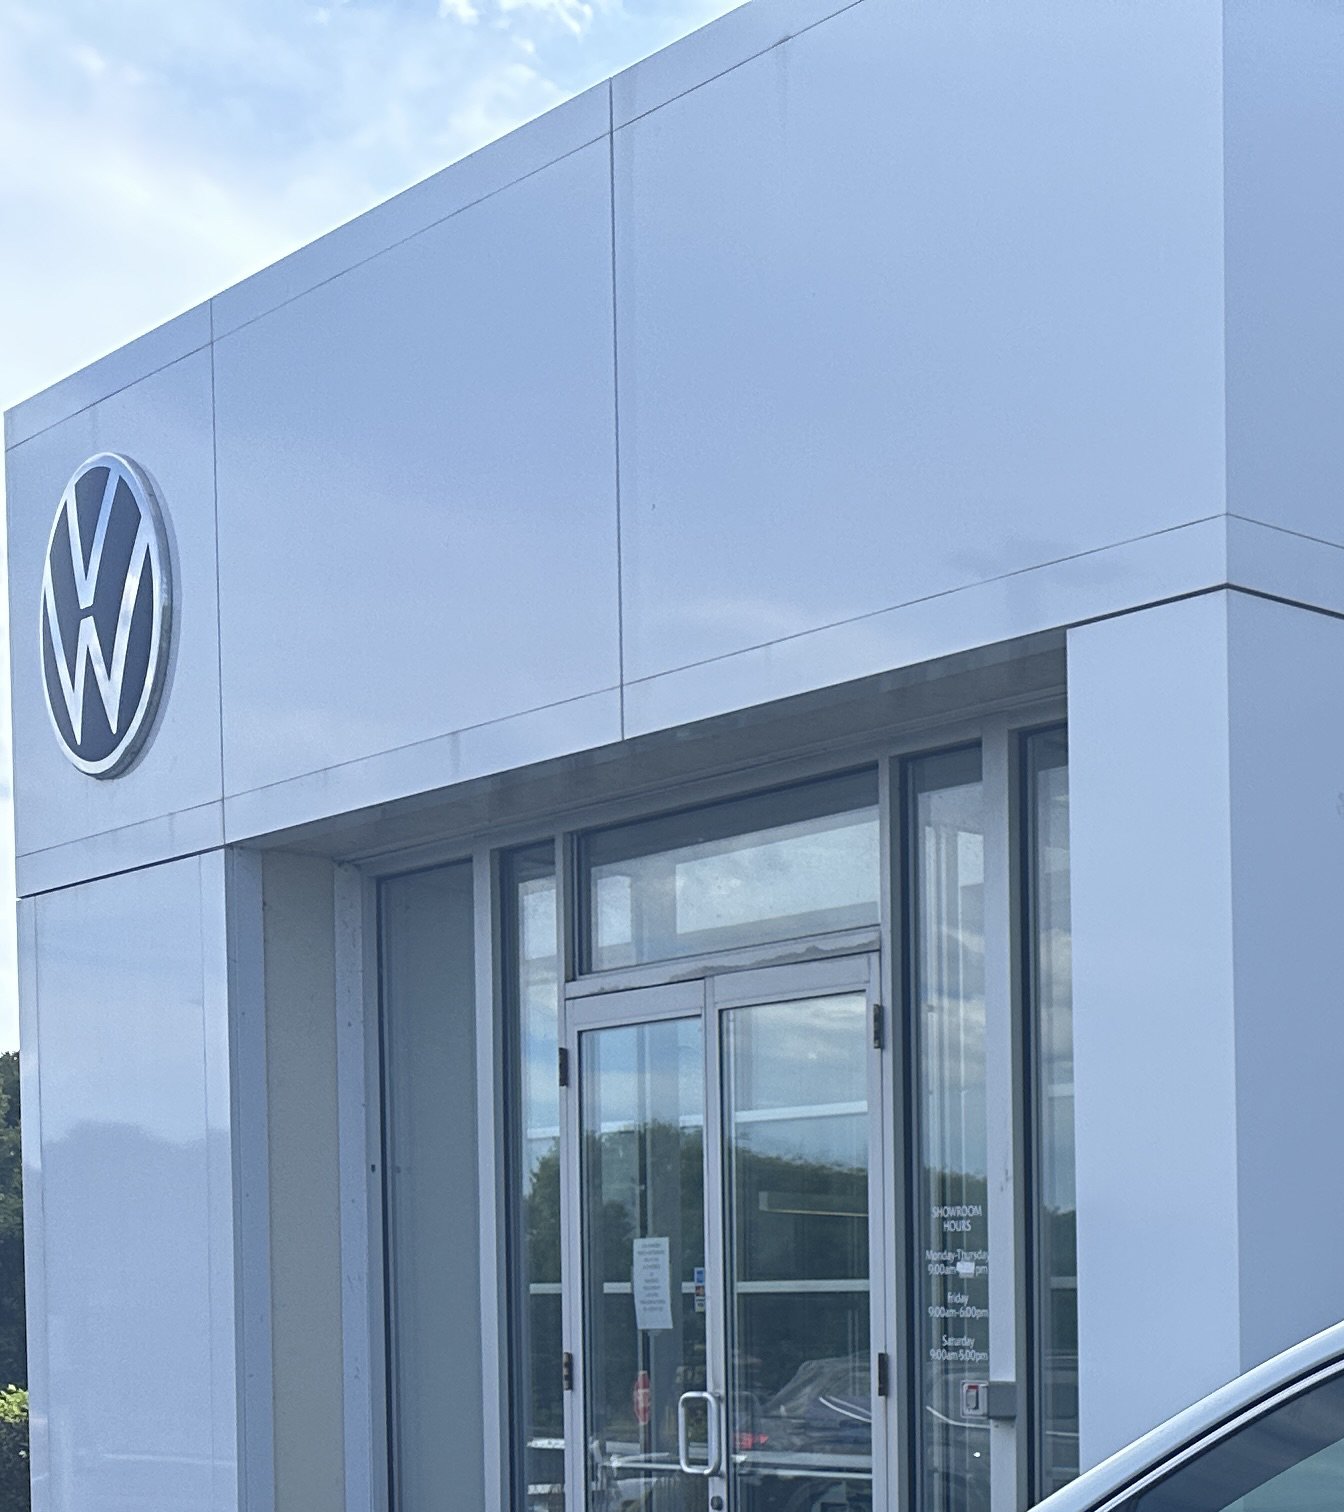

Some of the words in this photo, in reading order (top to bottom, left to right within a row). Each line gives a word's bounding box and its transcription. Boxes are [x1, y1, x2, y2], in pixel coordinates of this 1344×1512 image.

[931, 1205, 982, 1217] SHOWROOM
[943, 1220, 972, 1232] HOURS
[947, 1291, 969, 1305] Friday
[942, 1334, 974, 1348] Saturday
